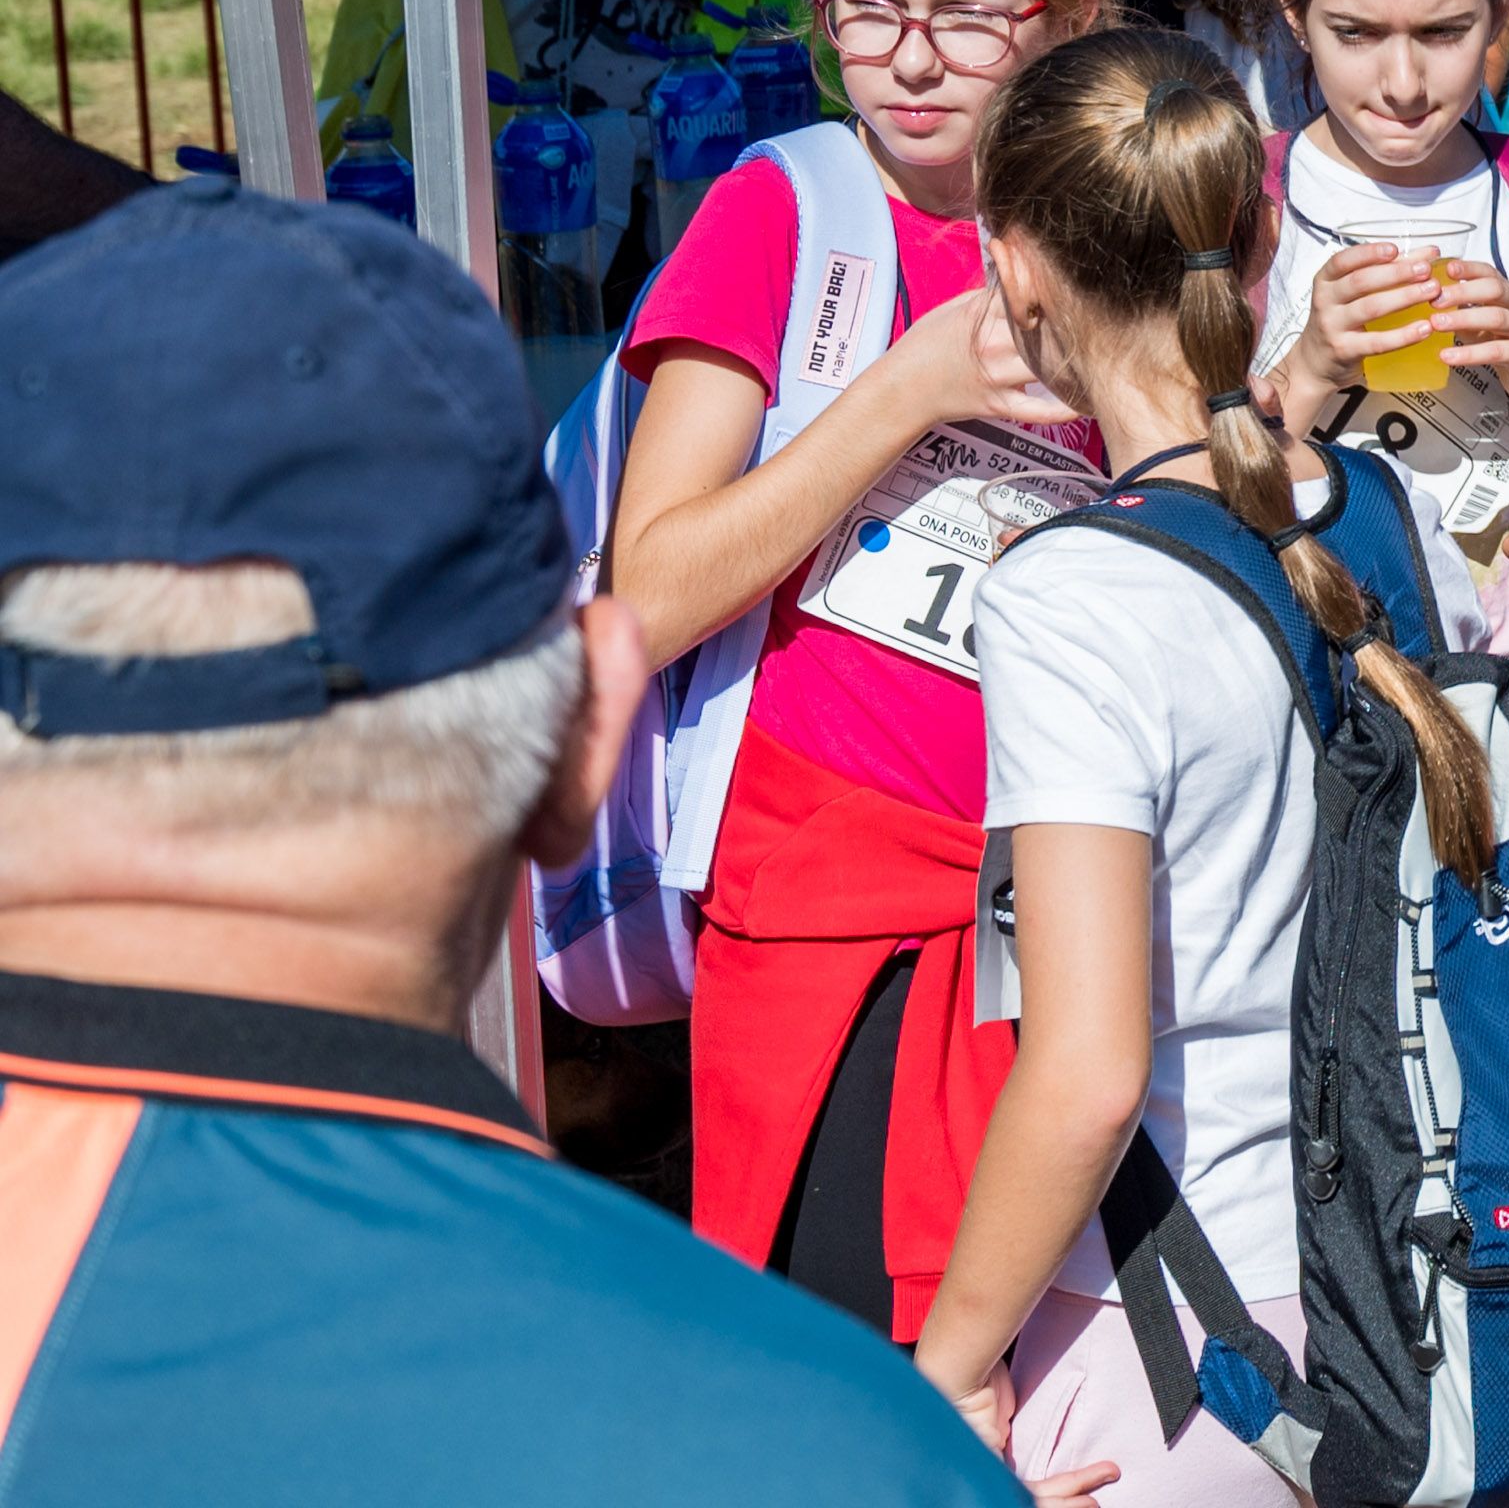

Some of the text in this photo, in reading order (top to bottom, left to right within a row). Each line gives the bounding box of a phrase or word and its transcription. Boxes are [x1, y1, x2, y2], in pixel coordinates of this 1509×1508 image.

[808, 261, 847, 373] NOT YOUR BAG!
[988, 452, 1011, 474] 52
[1010, 437, 1026, 453] NO
[1027, 444, 1044, 460] EM
[919, 513, 989, 552] ONA PONS
[903, 563, 978, 660] 1
